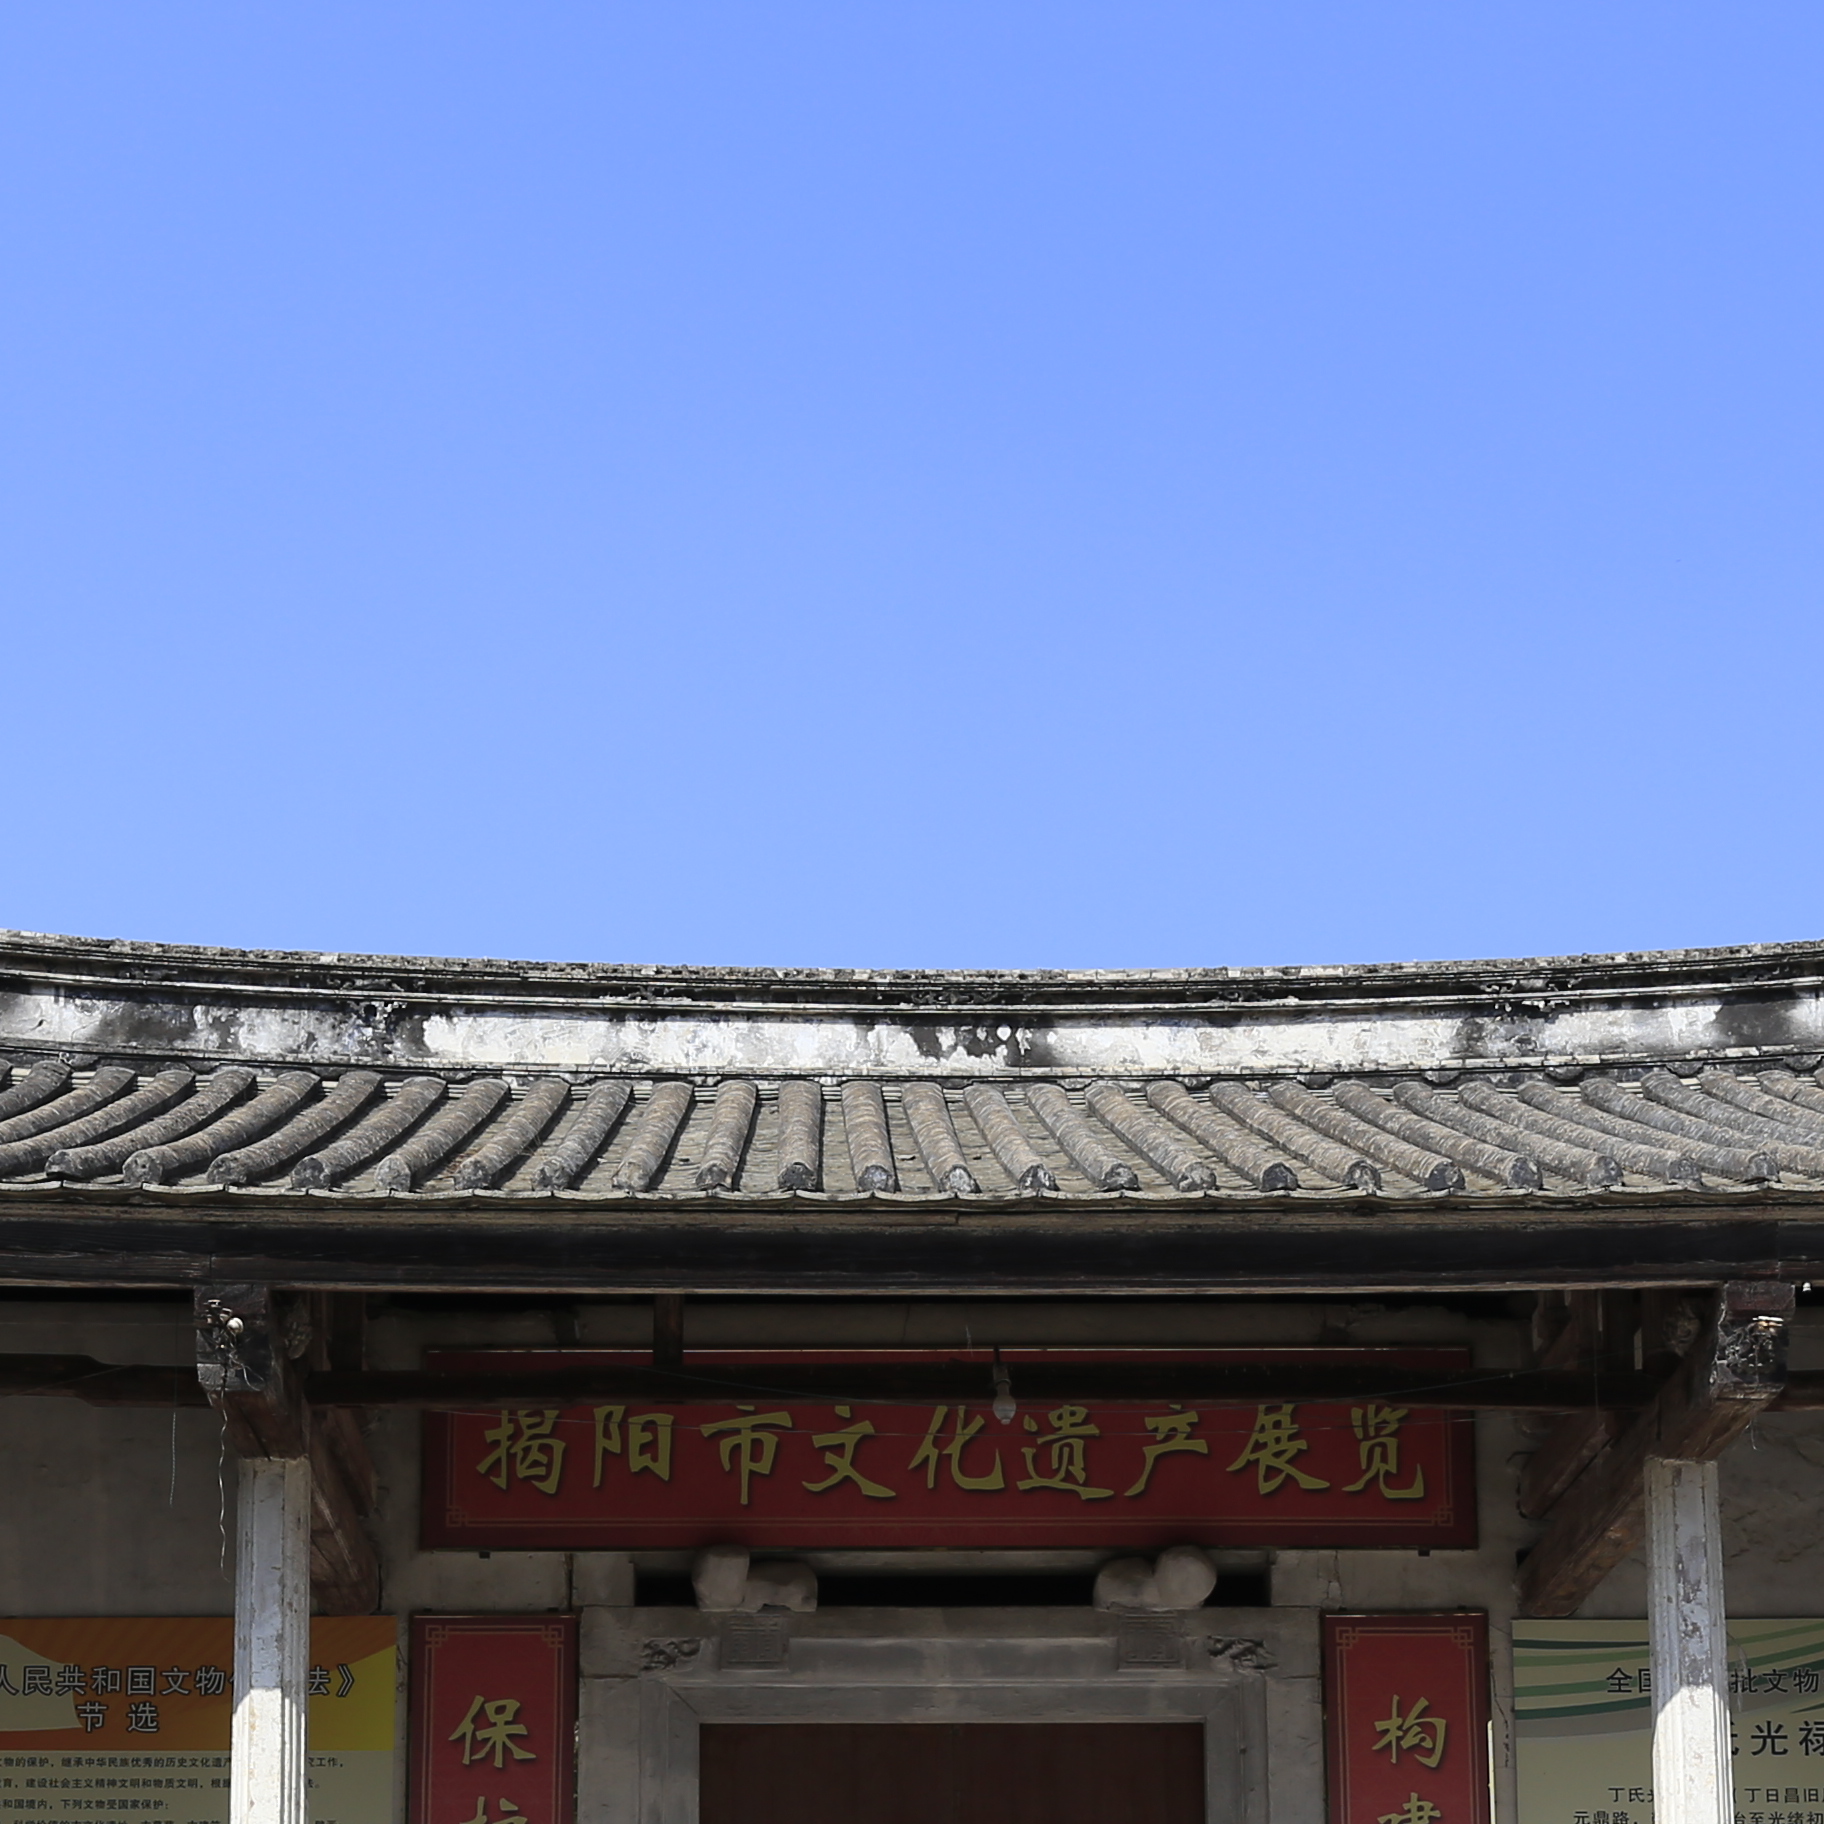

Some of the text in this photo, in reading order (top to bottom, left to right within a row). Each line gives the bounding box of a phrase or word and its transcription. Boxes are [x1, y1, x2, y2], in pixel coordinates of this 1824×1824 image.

[474, 1403, 1426, 1506] 揭阳市文化遗产展览
